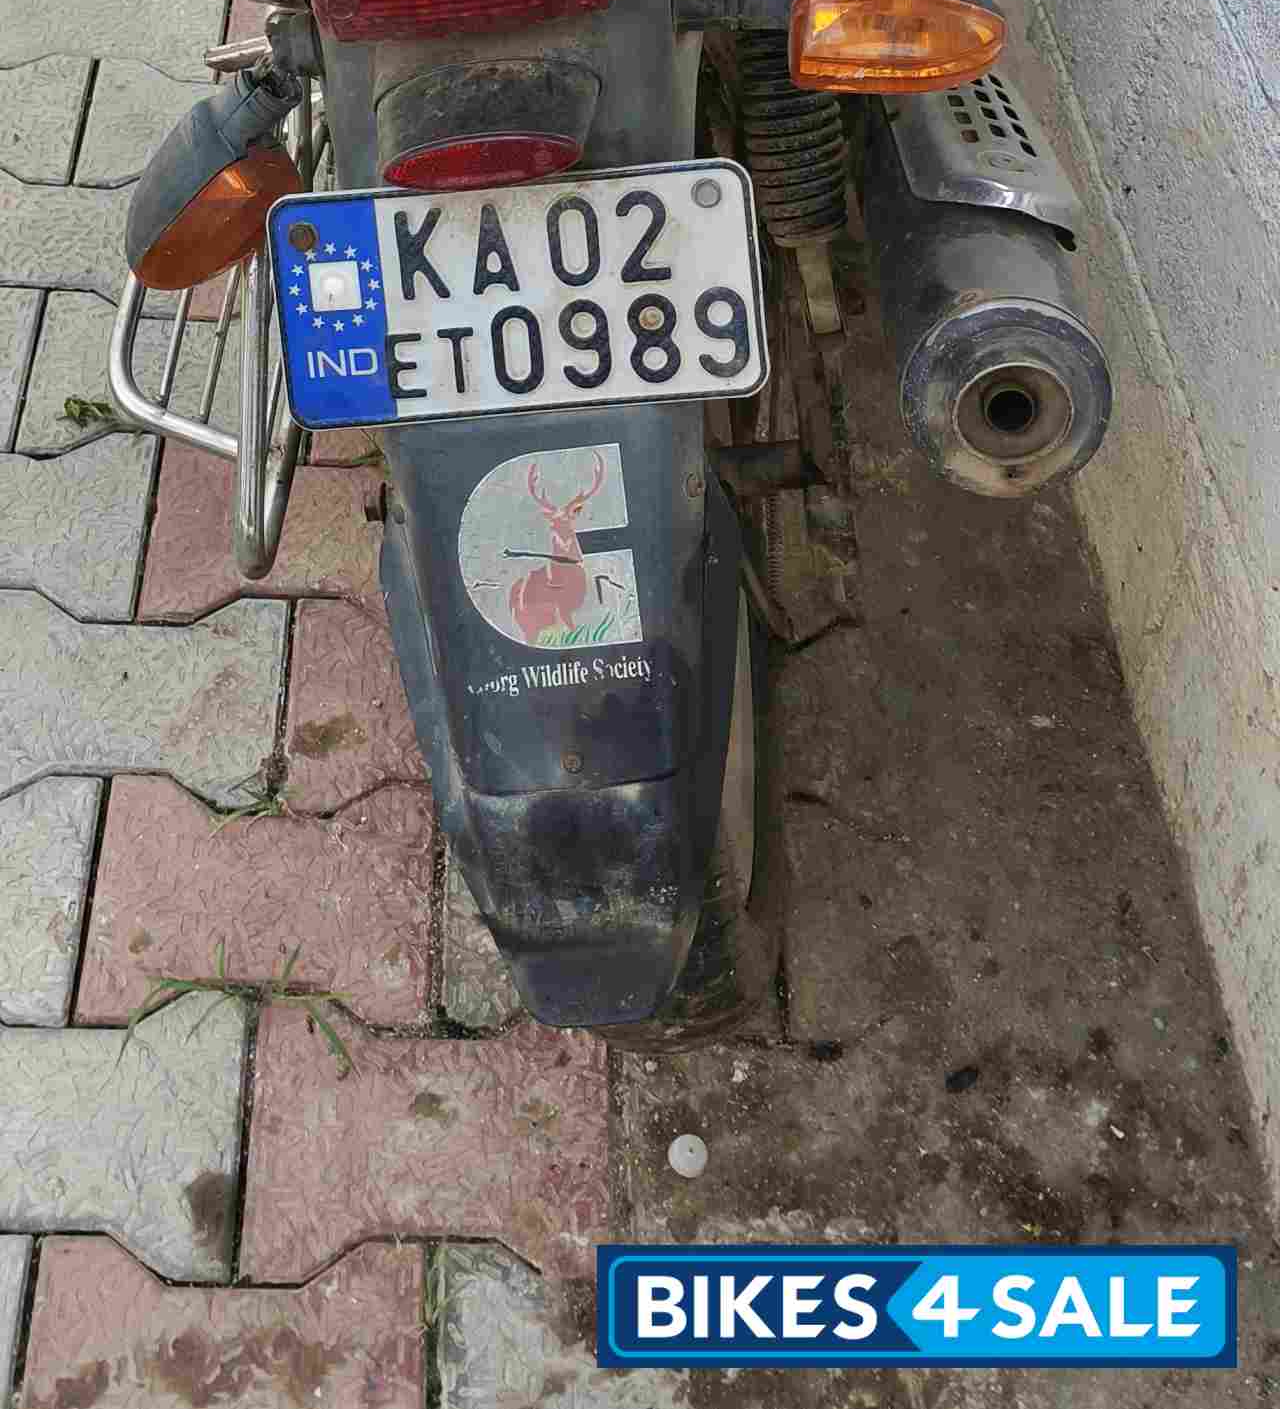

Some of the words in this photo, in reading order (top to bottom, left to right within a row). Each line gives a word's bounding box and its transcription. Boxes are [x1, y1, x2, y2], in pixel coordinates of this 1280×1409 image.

[306, 347, 378, 379] IND
[468, 673, 520, 697] org
[521, 661, 589, 689] Wildlife
